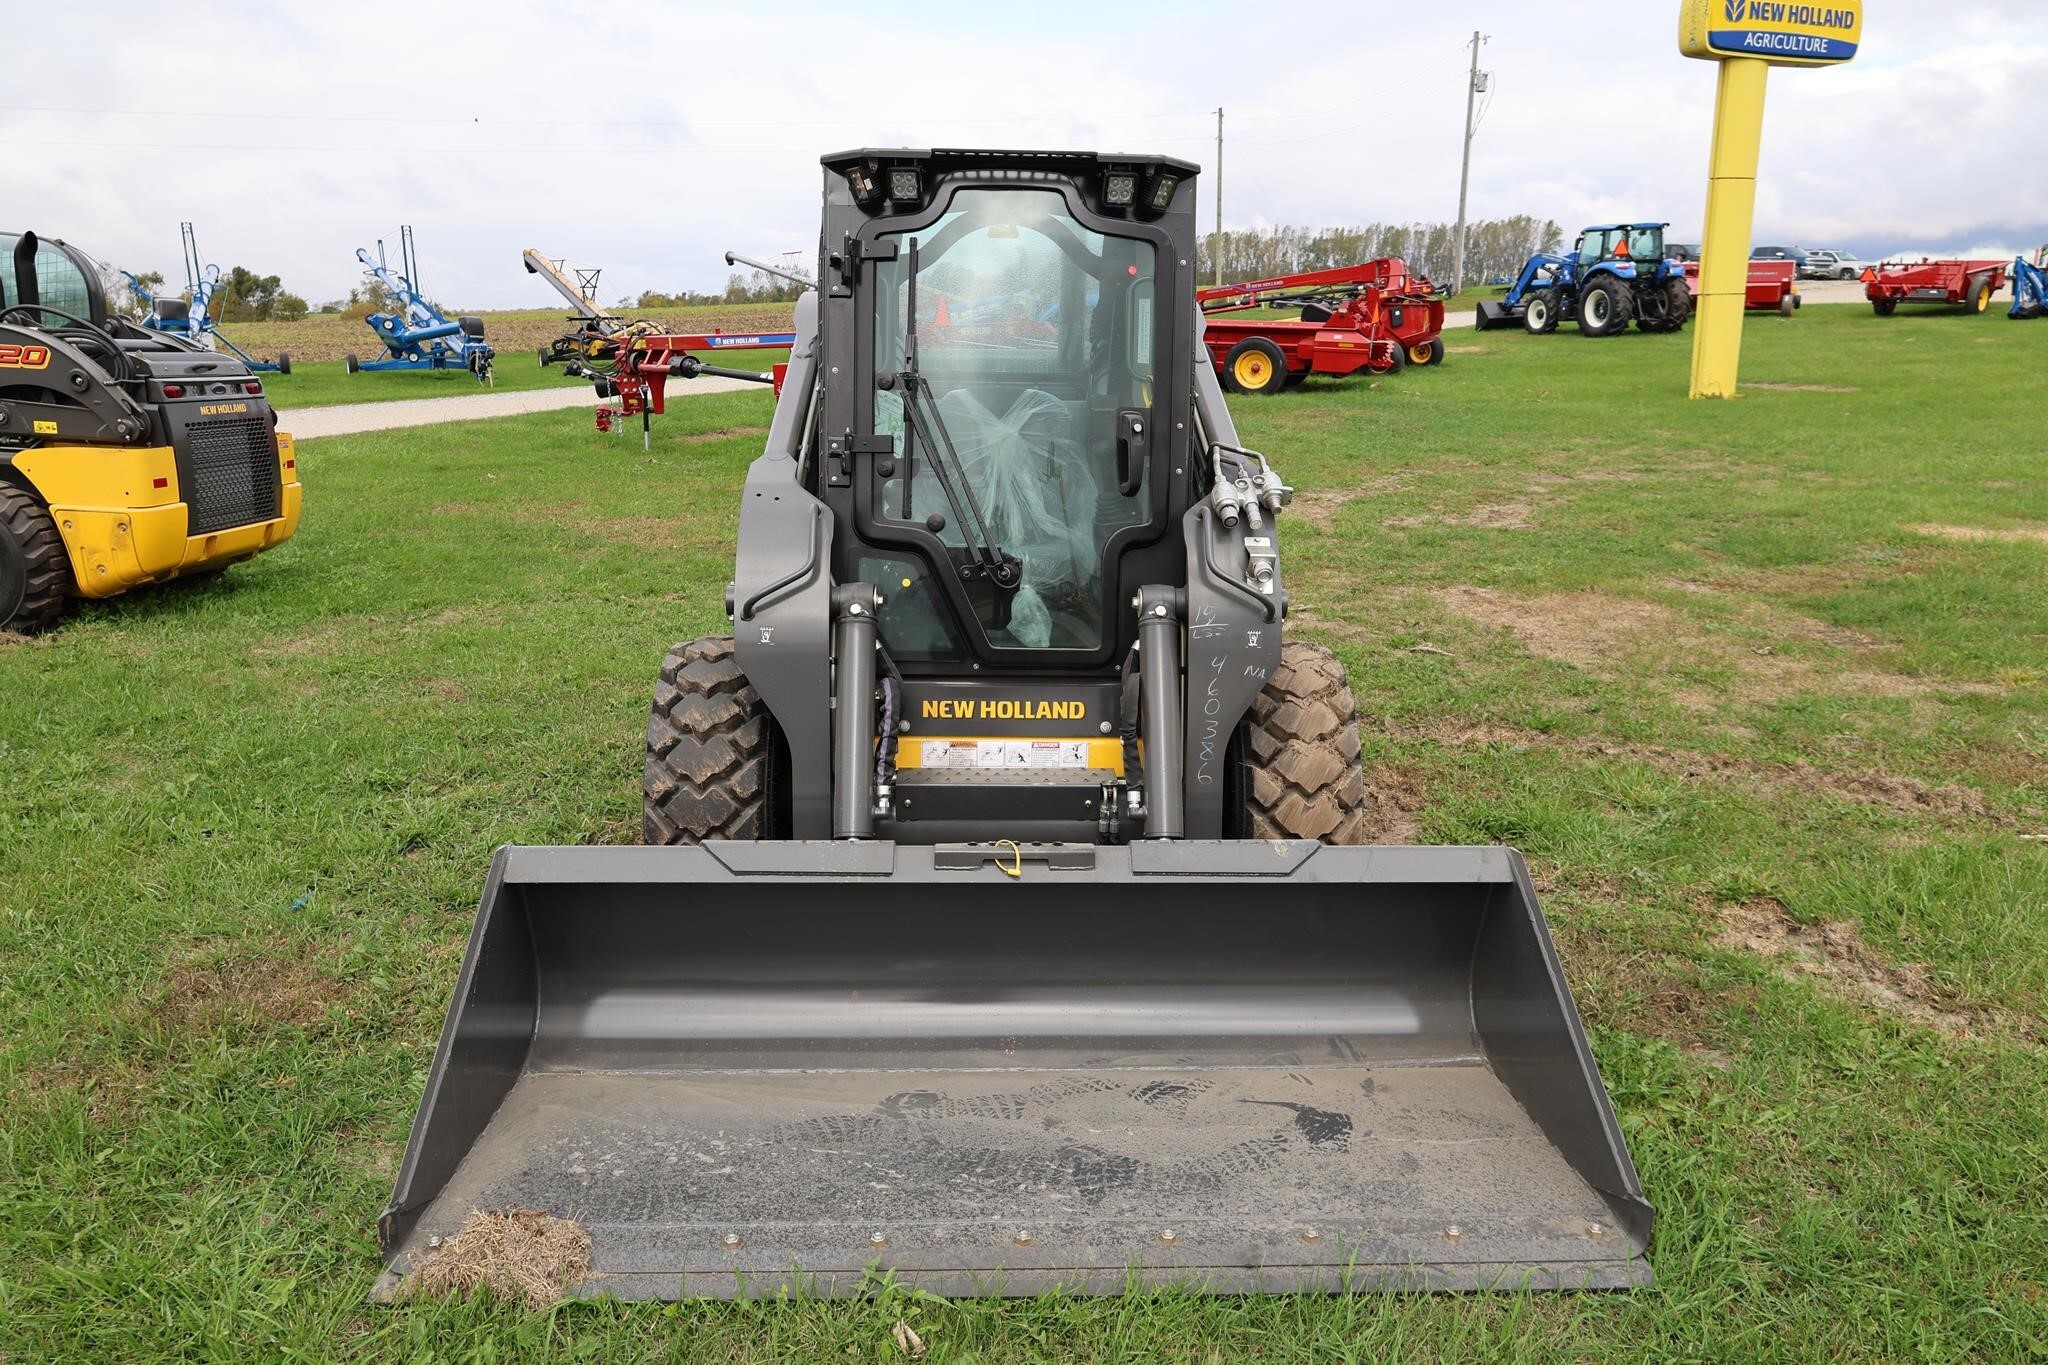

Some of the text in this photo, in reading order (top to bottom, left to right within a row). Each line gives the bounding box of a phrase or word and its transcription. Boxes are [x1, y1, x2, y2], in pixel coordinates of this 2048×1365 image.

[1749, 2, 1854, 29] NEW HOLLAND
[1744, 32, 1828, 53] AGRICULTURE
[735, 336, 760, 344] HOLLAND
[200, 403, 247, 415] NEW HOLLAND
[922, 700, 1086, 720] NEW HOLLAND
